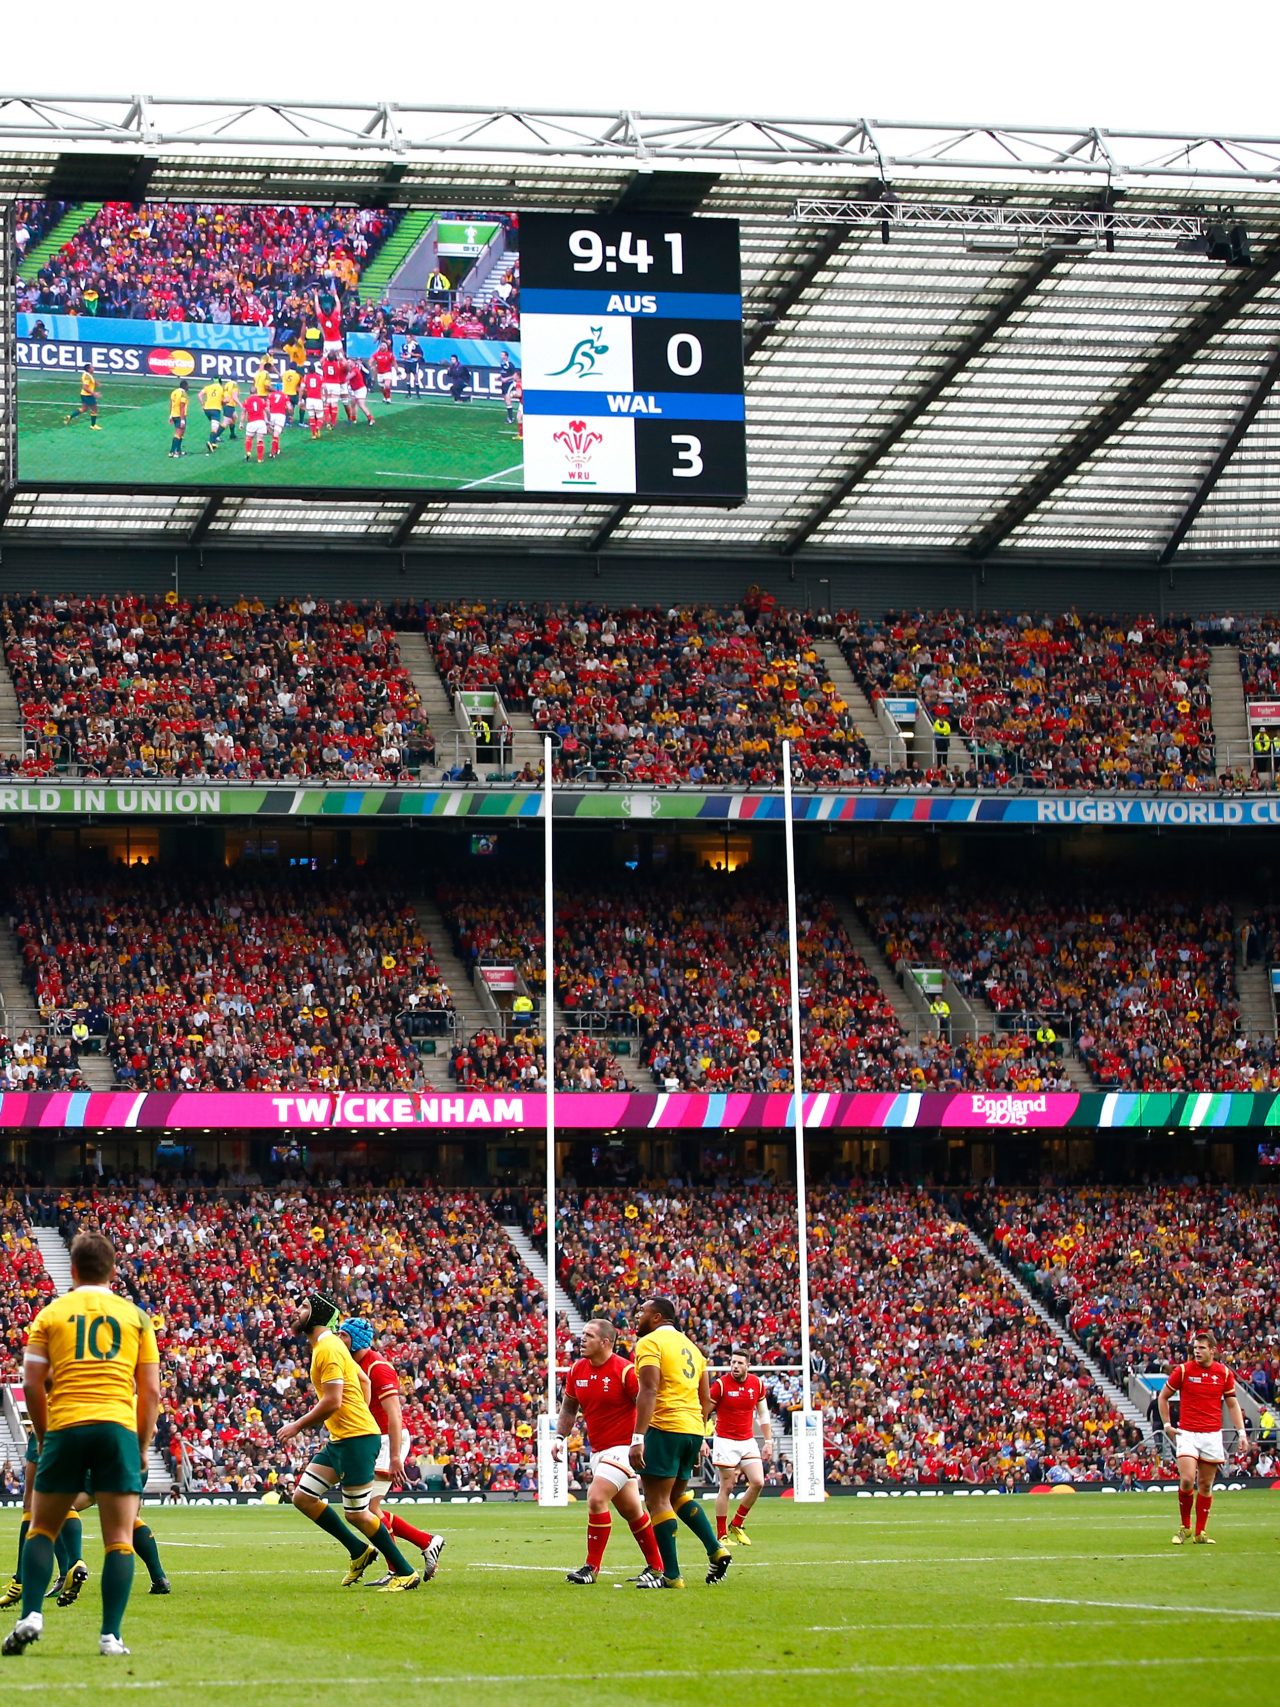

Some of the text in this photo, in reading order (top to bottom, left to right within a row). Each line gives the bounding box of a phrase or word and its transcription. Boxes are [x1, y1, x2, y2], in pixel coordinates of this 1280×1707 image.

[569, 230, 686, 276] 9:41
[606, 295, 658, 314] AUS
[667, 333, 703, 377] 0
[607, 394, 662, 414] WAL
[671, 434, 704, 478] 3
[568, 471, 590, 480] WRU
[73, 790, 105, 812] IN
[116, 790, 221, 814] UNION
[1037, 799, 1134, 824] RUGBY
[1142, 800, 1243, 825] WORLD
[272, 1098, 524, 1124] TWICKENHAM
[972, 1094, 1046, 1114] England
[985, 1110, 1028, 1126] 2015
[67, 1315, 122, 1361] 10
[681, 1348, 695, 1379] 3
[808, 1461, 820, 1496] England
